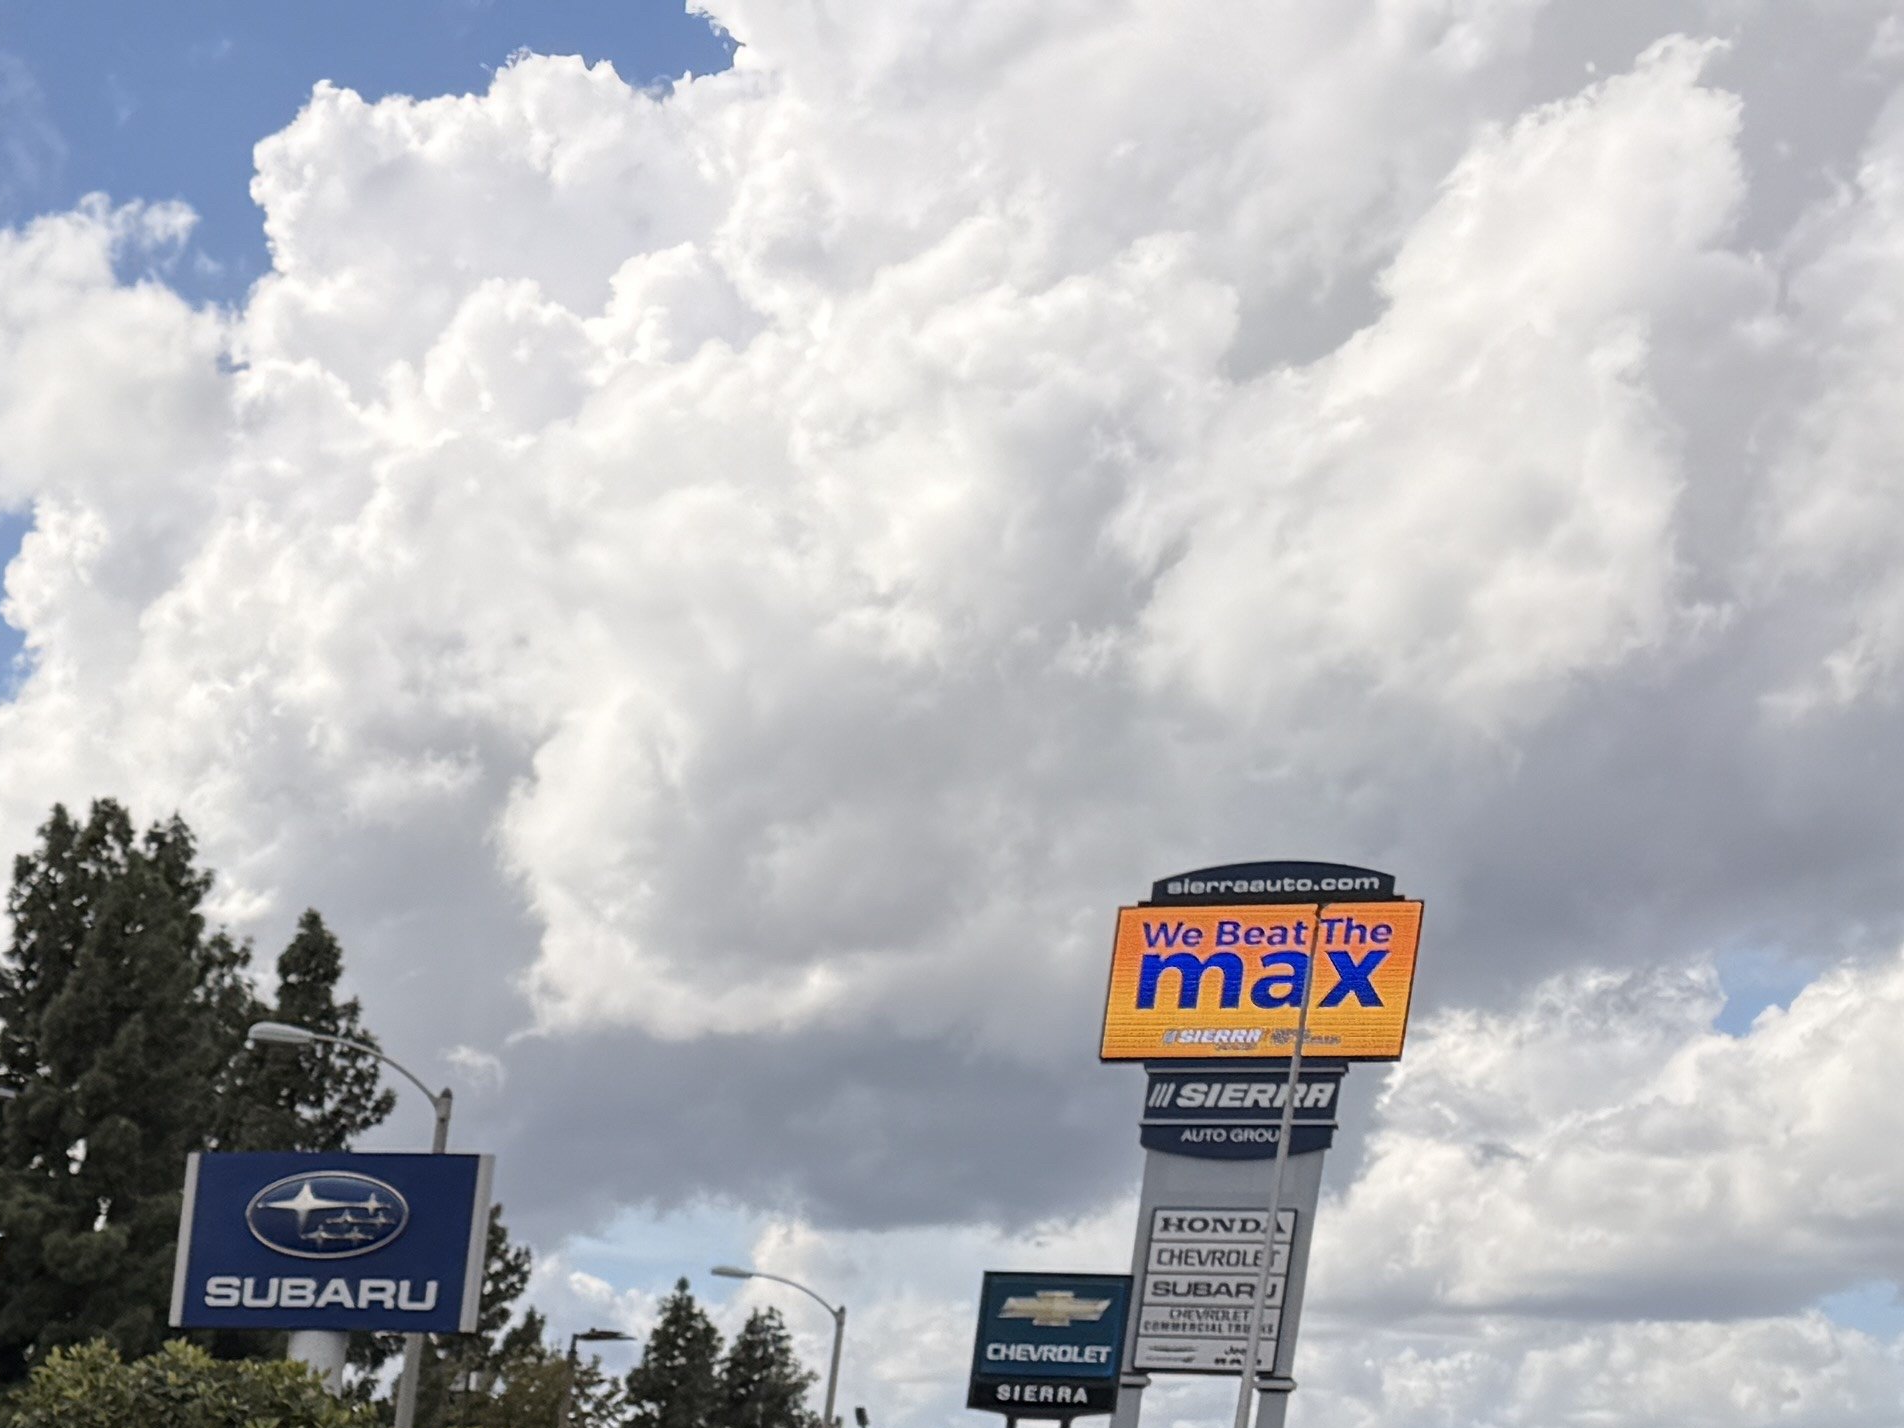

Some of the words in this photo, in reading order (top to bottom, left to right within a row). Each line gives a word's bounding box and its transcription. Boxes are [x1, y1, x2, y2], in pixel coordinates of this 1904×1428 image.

[1167, 876, 1380, 894] sierraauto.com
[1143, 921, 1203, 947] We
[1216, 920, 1308, 946] Beat
[1321, 916, 1392, 944] The
[1136, 950, 1390, 1010] max
[1176, 1083, 1336, 1108] SIERRA
[1181, 1128, 1225, 1143] AUTO
[1230, 1128, 1281, 1143] GROU
[1159, 1217, 1287, 1234] HONDA
[205, 1275, 439, 1311] SUBARU
[986, 1343, 1112, 1363] CHEVROLET
[996, 1384, 1089, 1403] SIERRA
